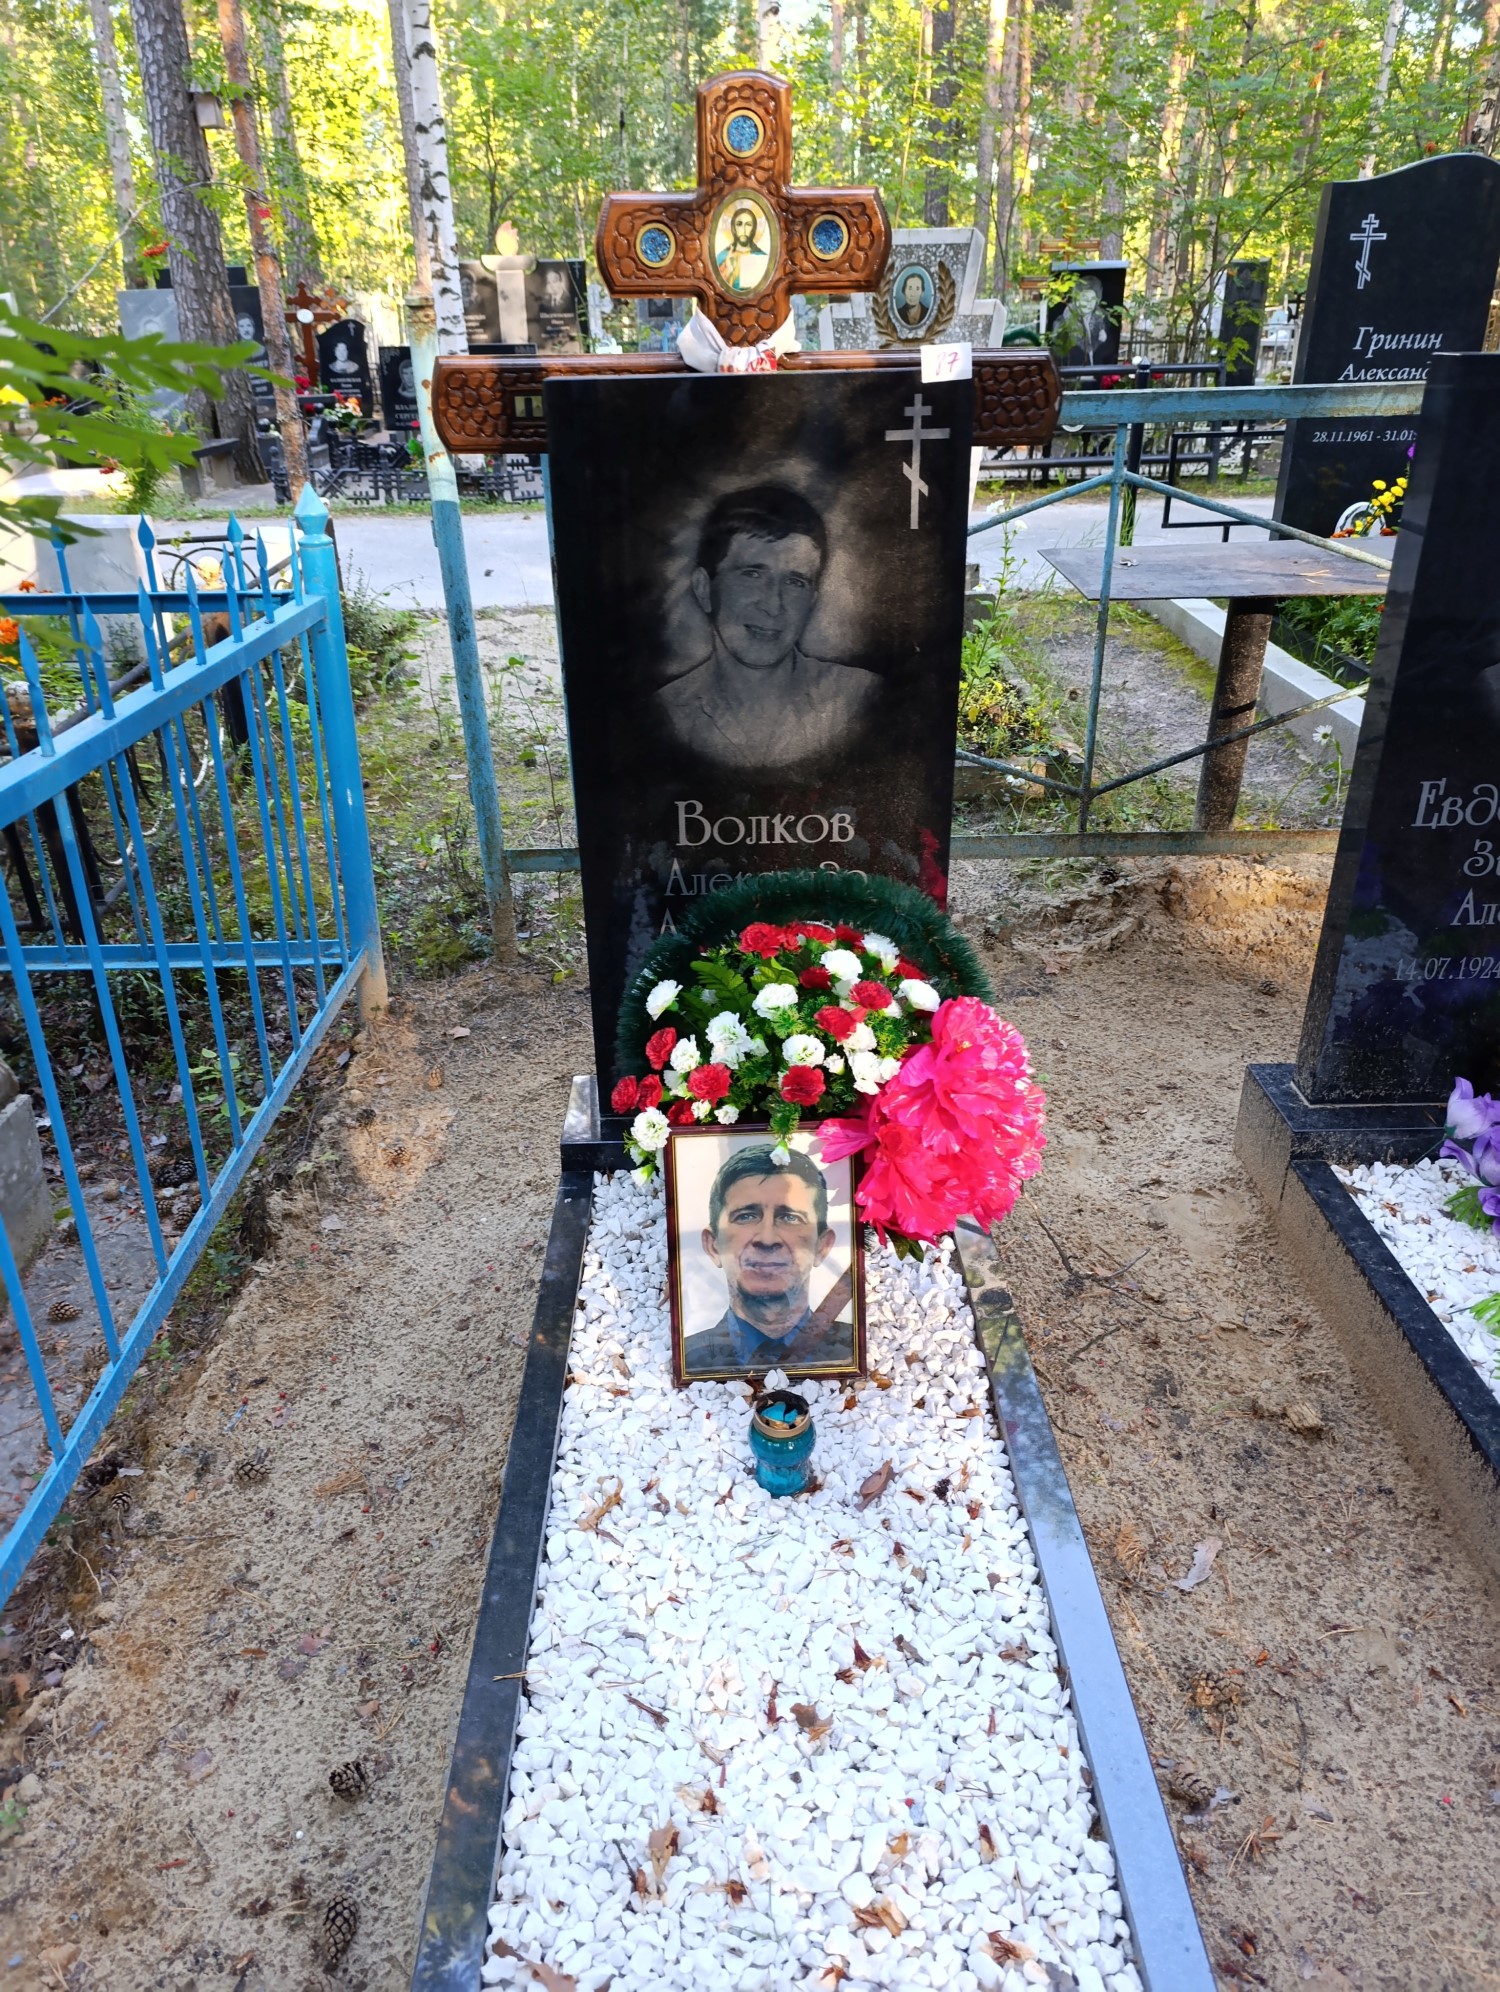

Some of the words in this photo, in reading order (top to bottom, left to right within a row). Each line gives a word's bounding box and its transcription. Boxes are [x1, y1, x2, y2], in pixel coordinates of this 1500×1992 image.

[1352, 326, 1444, 359] Гринин
[1312, 431, 1375, 443] 28.11.1961
[674, 799, 856, 847] Волков
[1411, 777, 1500, 830] Евд
